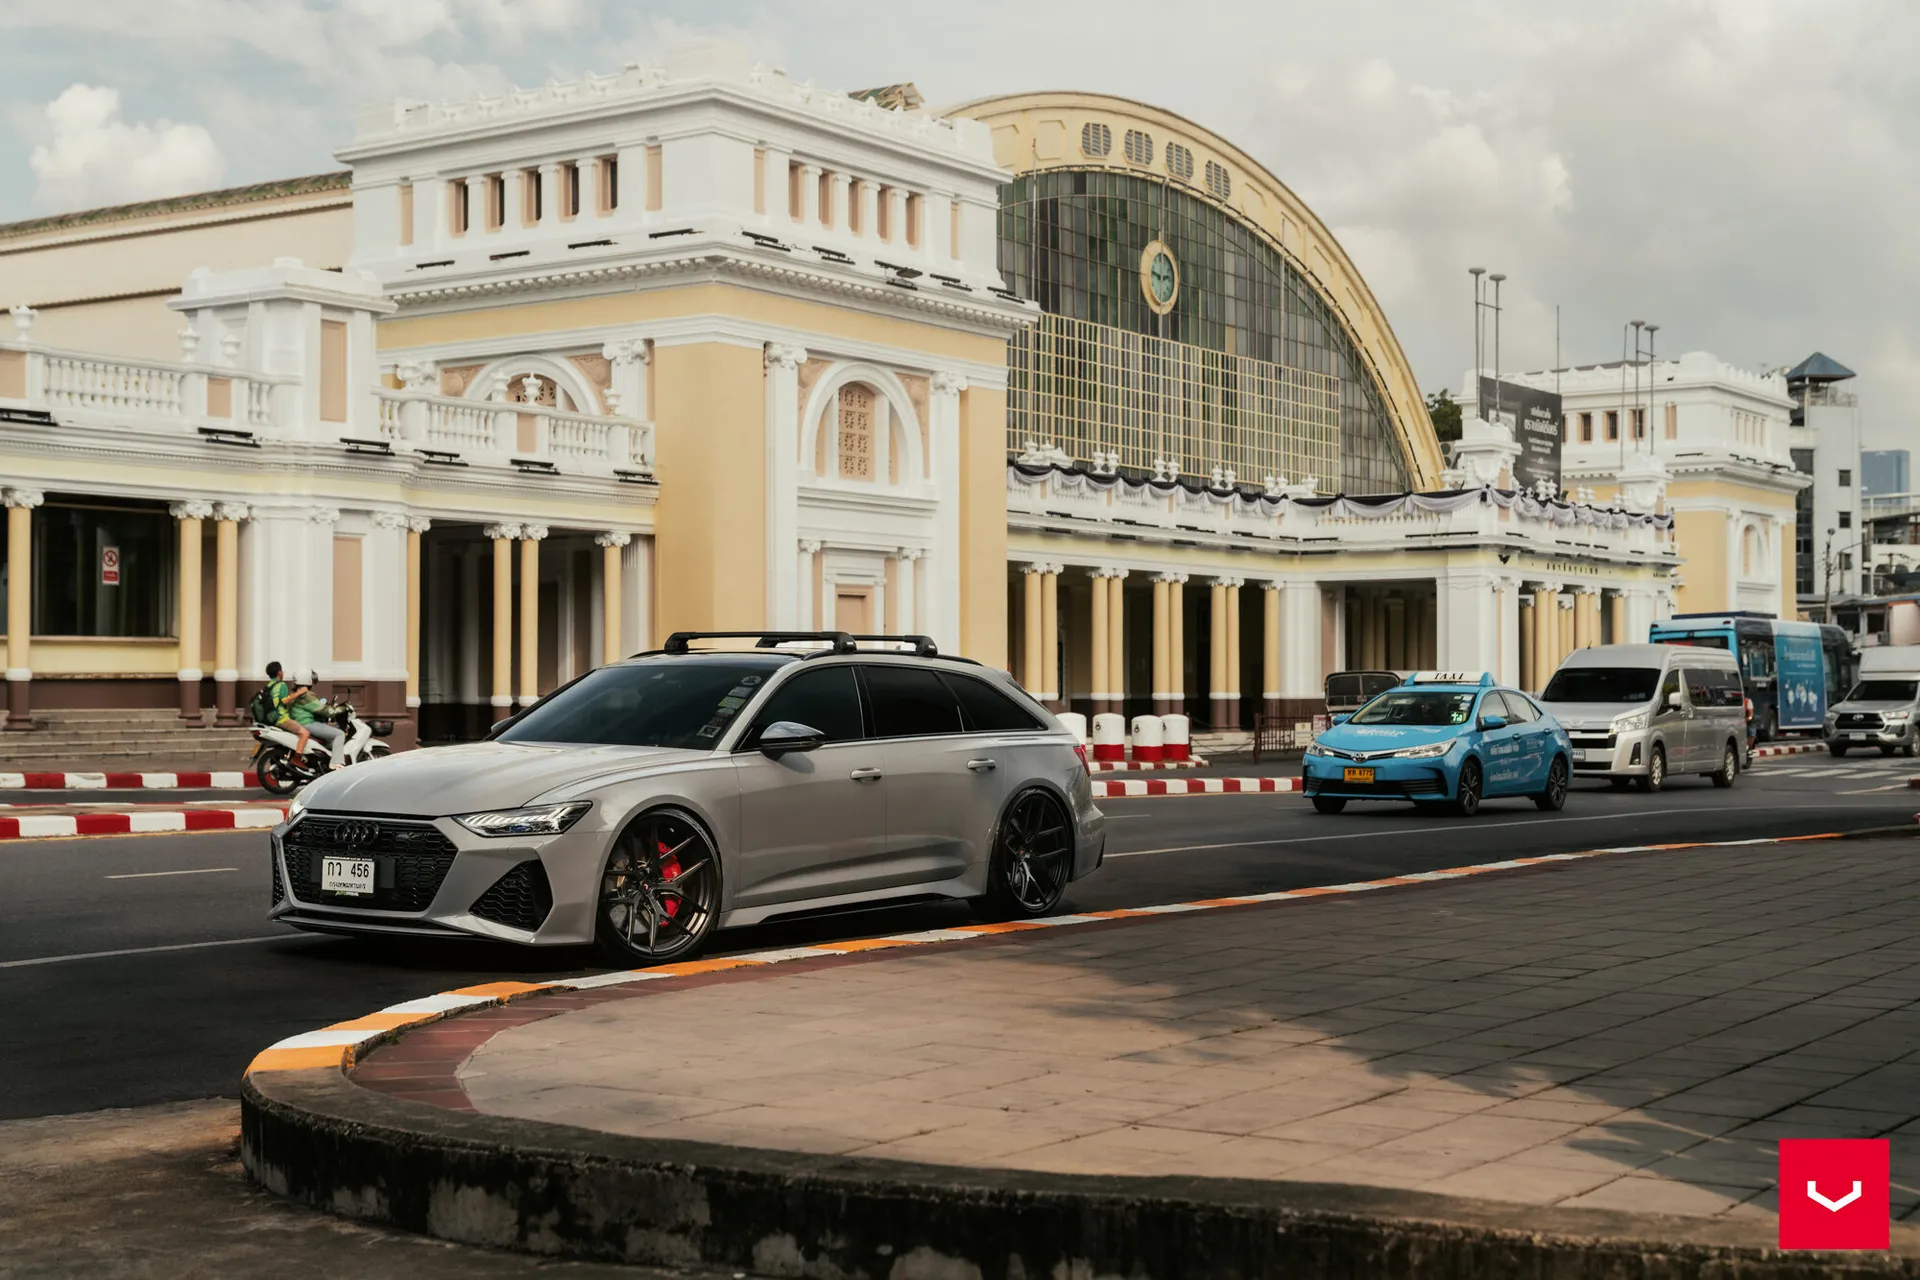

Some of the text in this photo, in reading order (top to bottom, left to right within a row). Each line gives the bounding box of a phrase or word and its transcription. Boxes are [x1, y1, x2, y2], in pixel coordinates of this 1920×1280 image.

[1434, 672, 1464, 680] TAXI
[327, 861, 370, 878] กว 456
